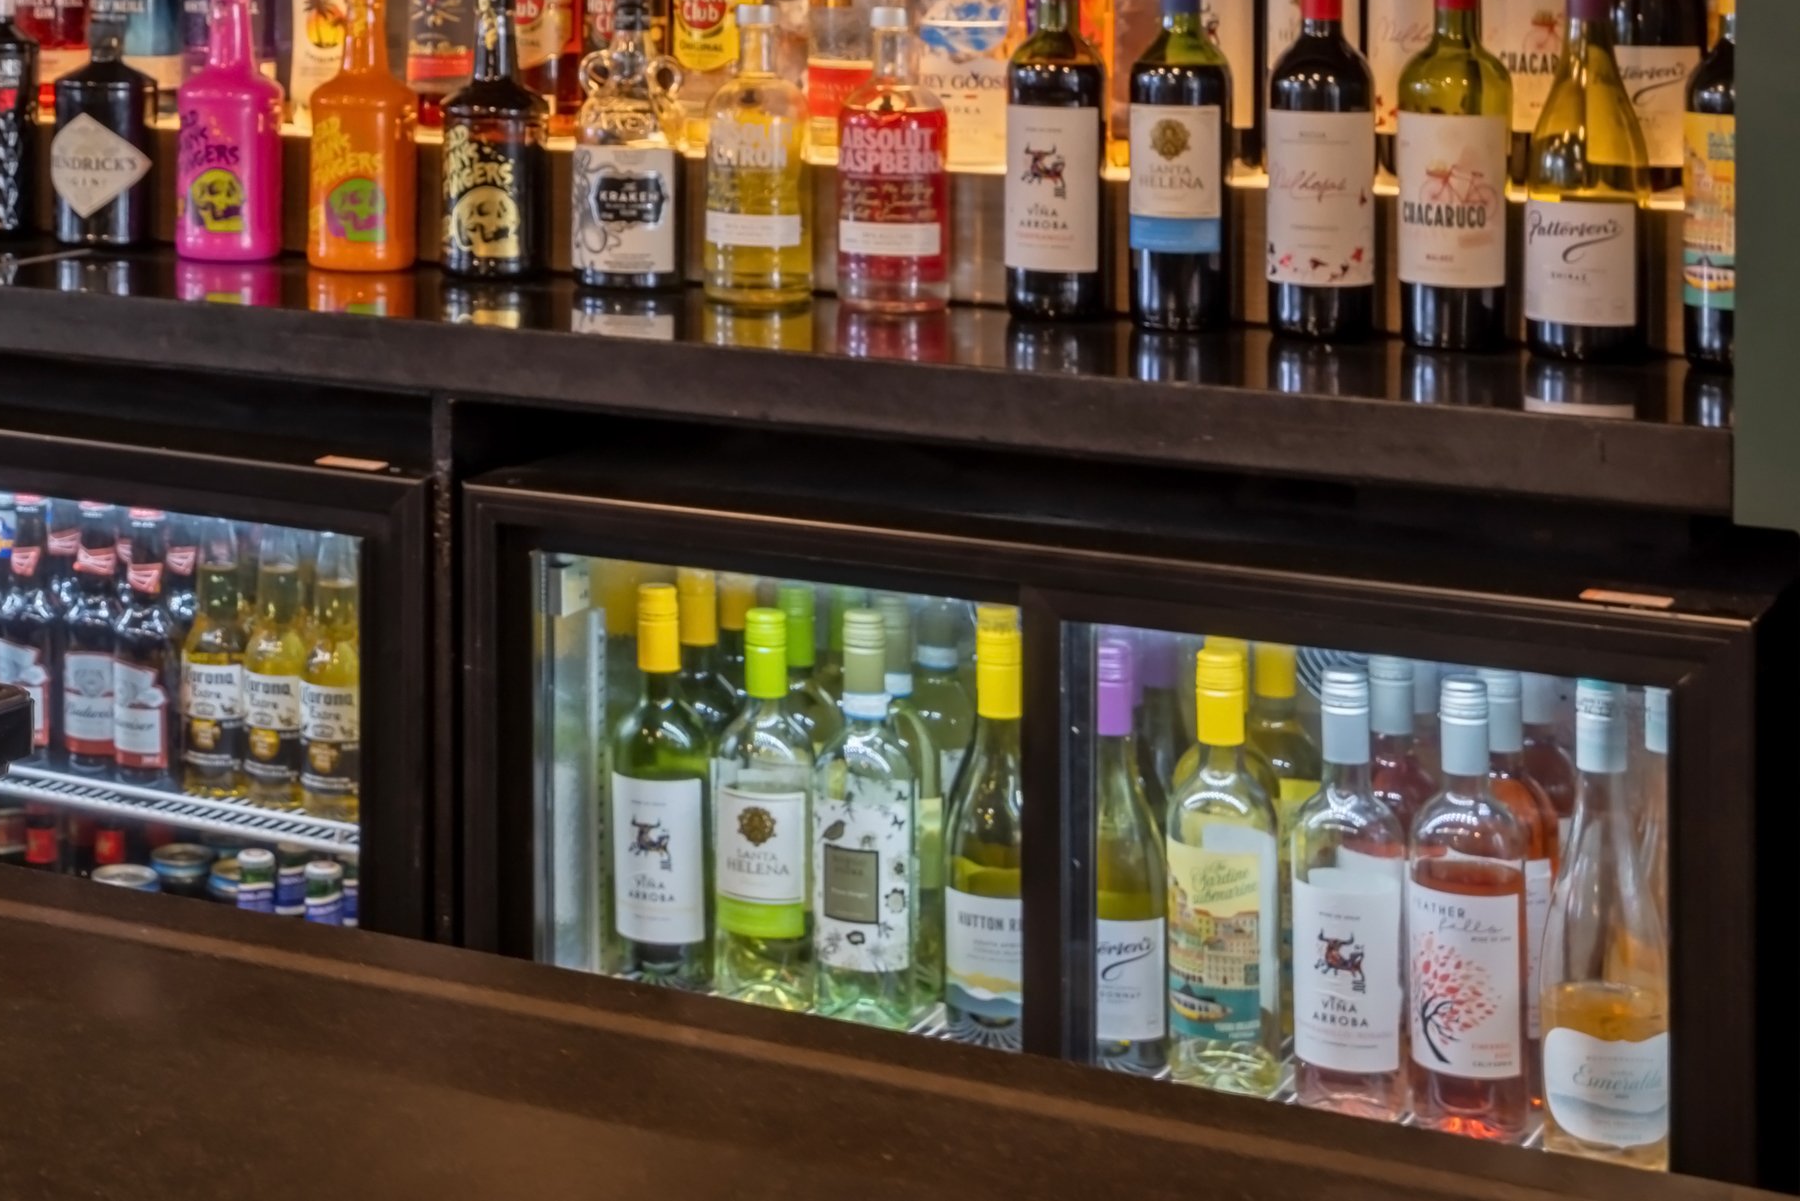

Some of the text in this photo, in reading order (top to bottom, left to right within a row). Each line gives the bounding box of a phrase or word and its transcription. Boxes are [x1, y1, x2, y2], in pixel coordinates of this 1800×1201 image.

[681, 1, 719, 22] Club
[842, 127, 935, 151] ABSOLUT
[1149, 164, 1192, 176] SANTA
[71, 177, 100, 187] GIN
[1139, 176, 1204, 190] HELENA
[600, 190, 660, 203] KRAKEN
[1019, 219, 1069, 230] ARROBA
[303, 683, 354, 706] Corona
[737, 849, 777, 861] SANTA
[726, 858, 790, 876] HELENA
[1321, 996, 1357, 1013] VIÑA
[1312, 1012, 1369, 1028] ARROBA
